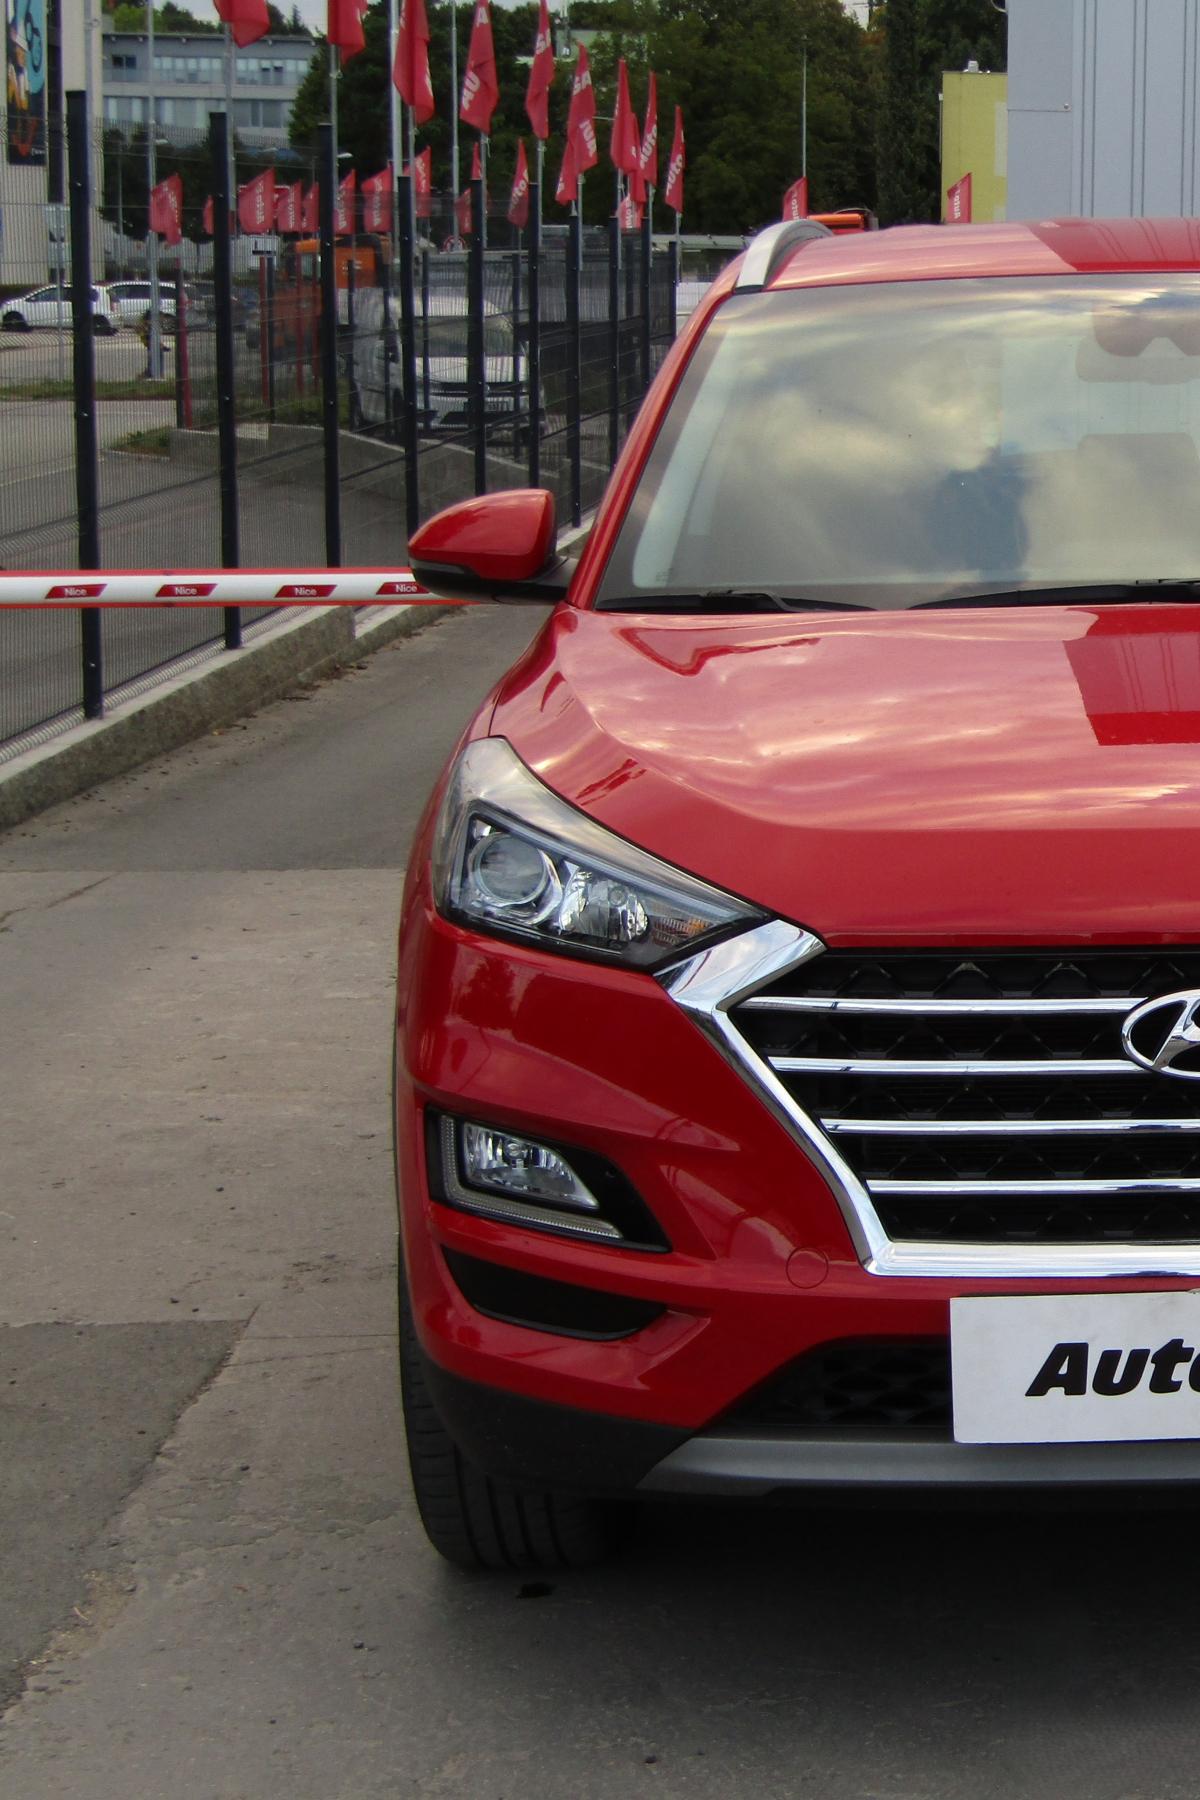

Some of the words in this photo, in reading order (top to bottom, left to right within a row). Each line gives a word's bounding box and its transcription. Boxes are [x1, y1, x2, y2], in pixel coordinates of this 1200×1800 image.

[63, 587, 88, 597] Nice
[174, 586, 198, 595] Nice
[294, 587, 318, 596] Nice
[394, 584, 418, 593] Nice
